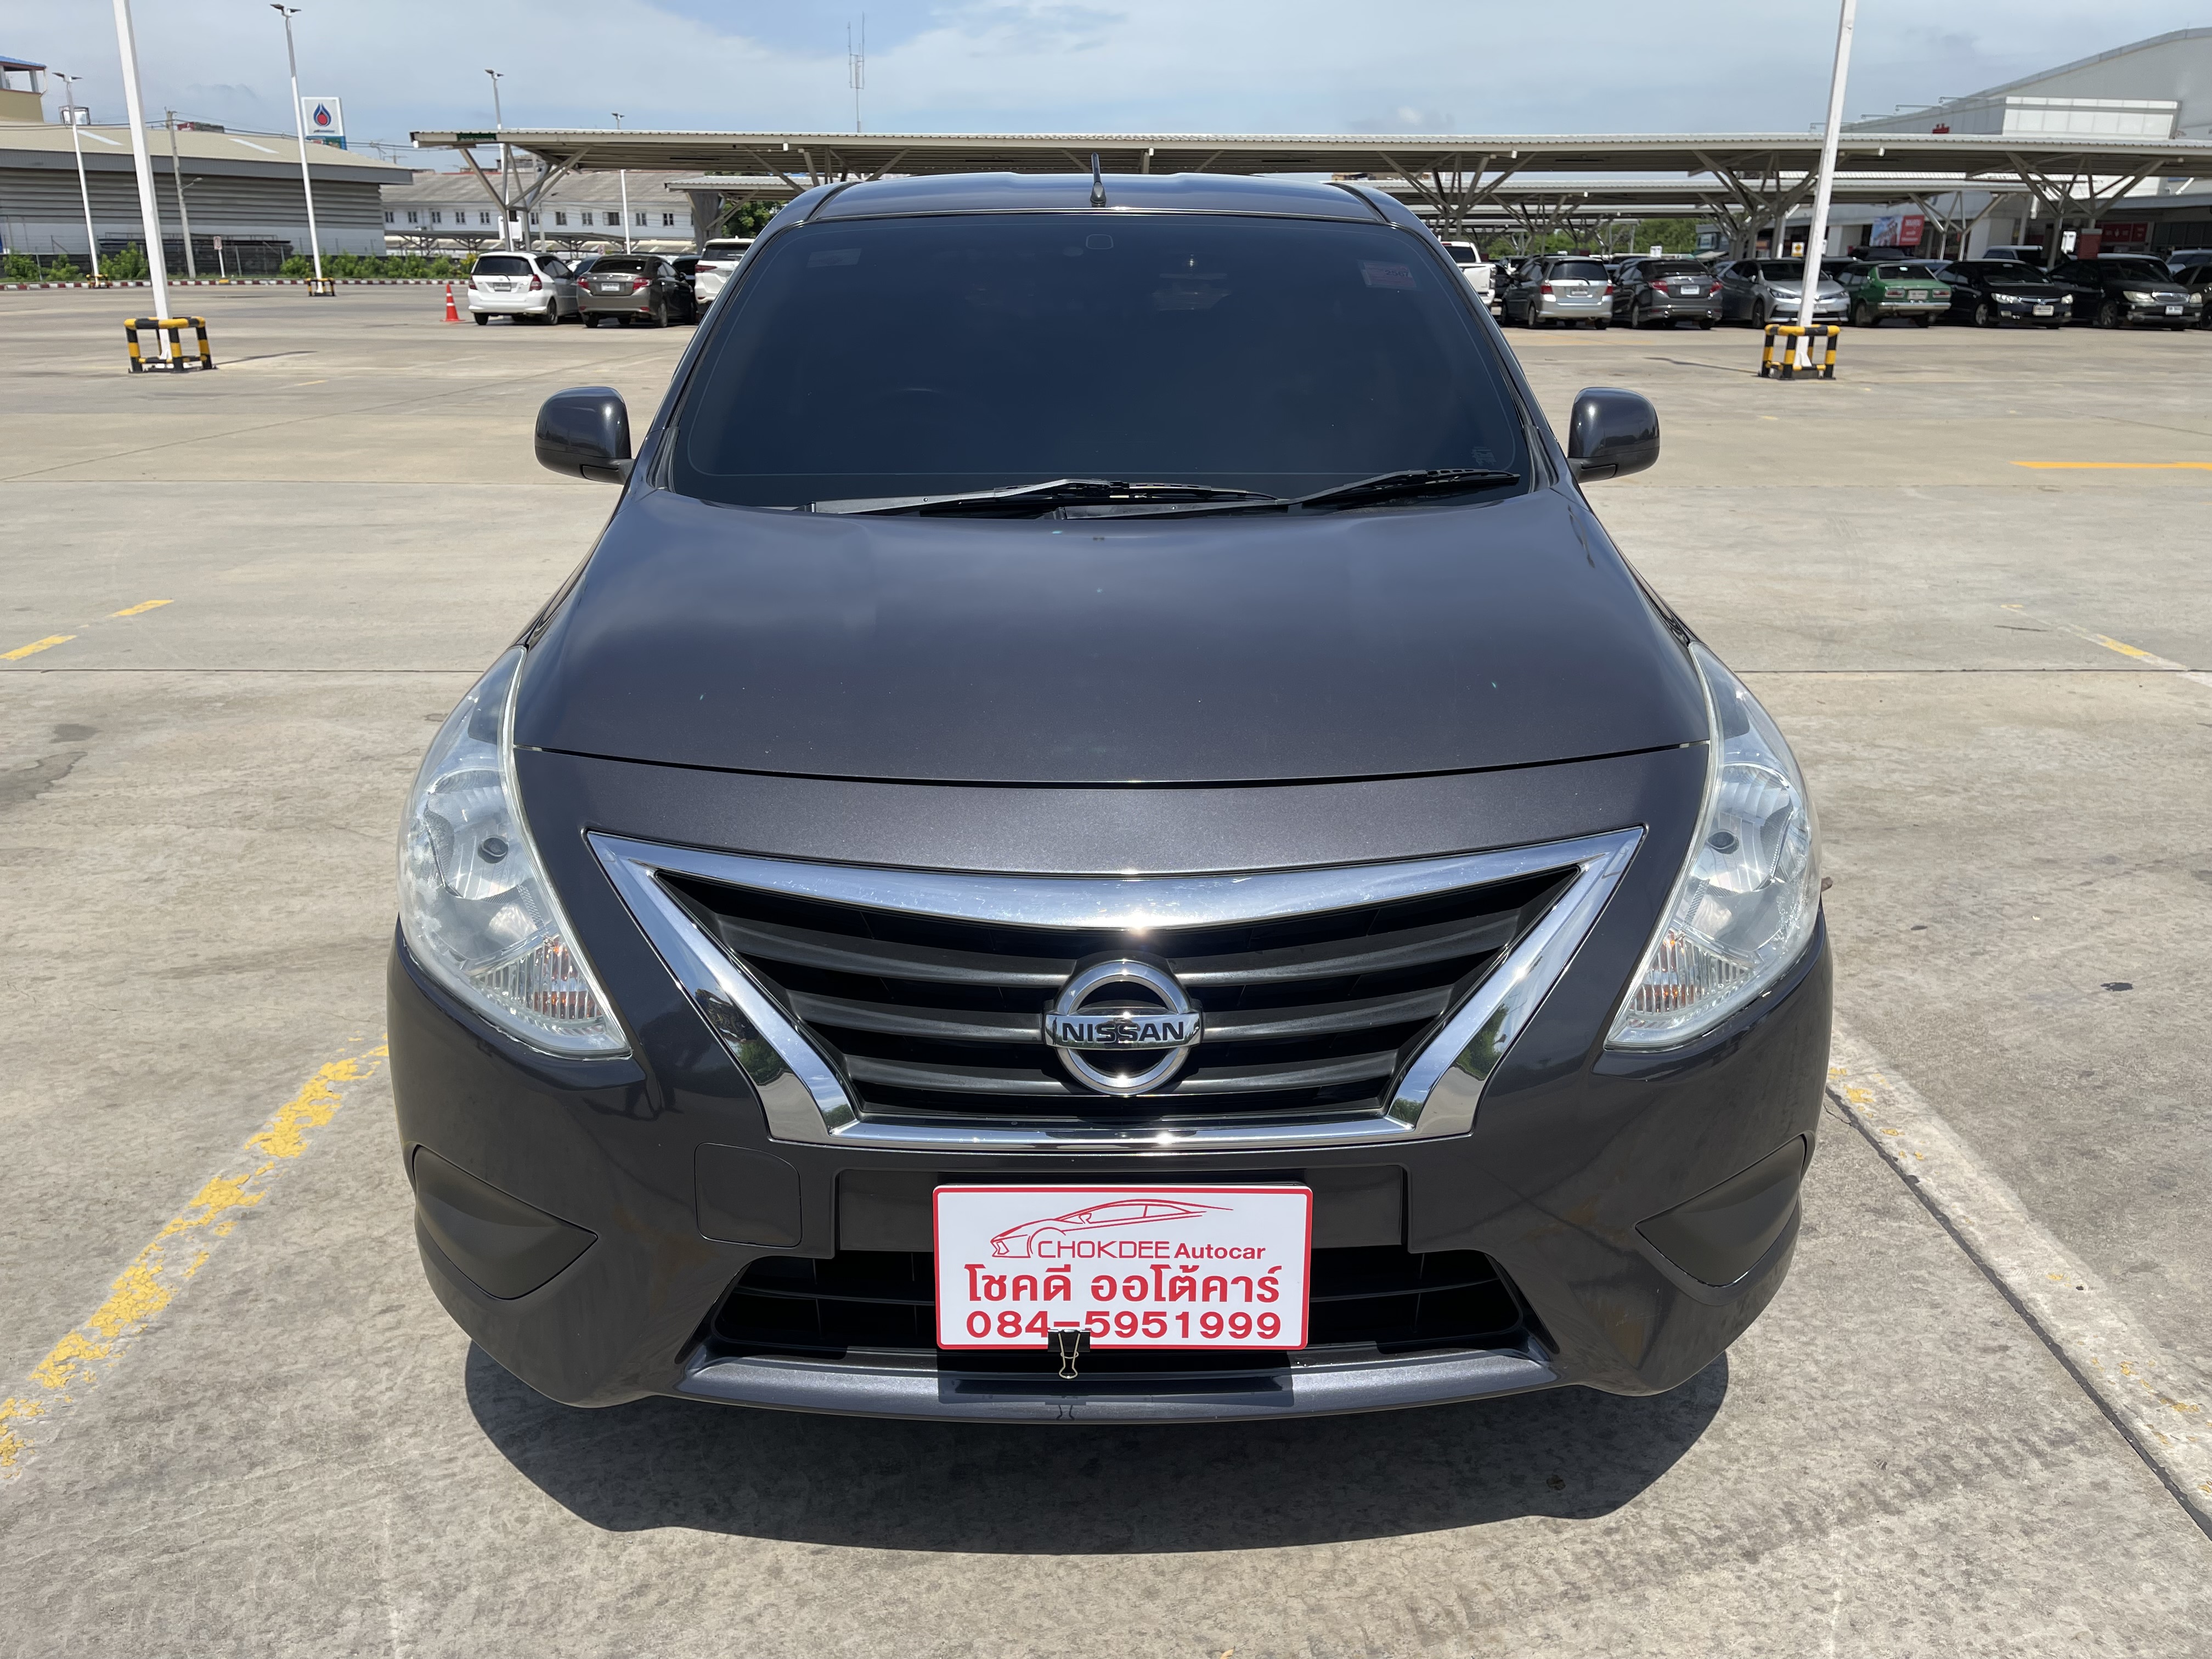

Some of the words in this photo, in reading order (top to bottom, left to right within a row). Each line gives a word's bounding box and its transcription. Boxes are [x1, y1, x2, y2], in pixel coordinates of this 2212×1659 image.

[1062, 1021, 1184, 1043] NISSAN
[1037, 1240, 1170, 1259] CHOKDEE
[1174, 1242, 1266, 1260] Autocar
[964, 1263, 1071, 1302] โชคดี
[1091, 1263, 1283, 1304] ออโต้คาร์
[966, 1310, 1282, 1340] 084-5951999
